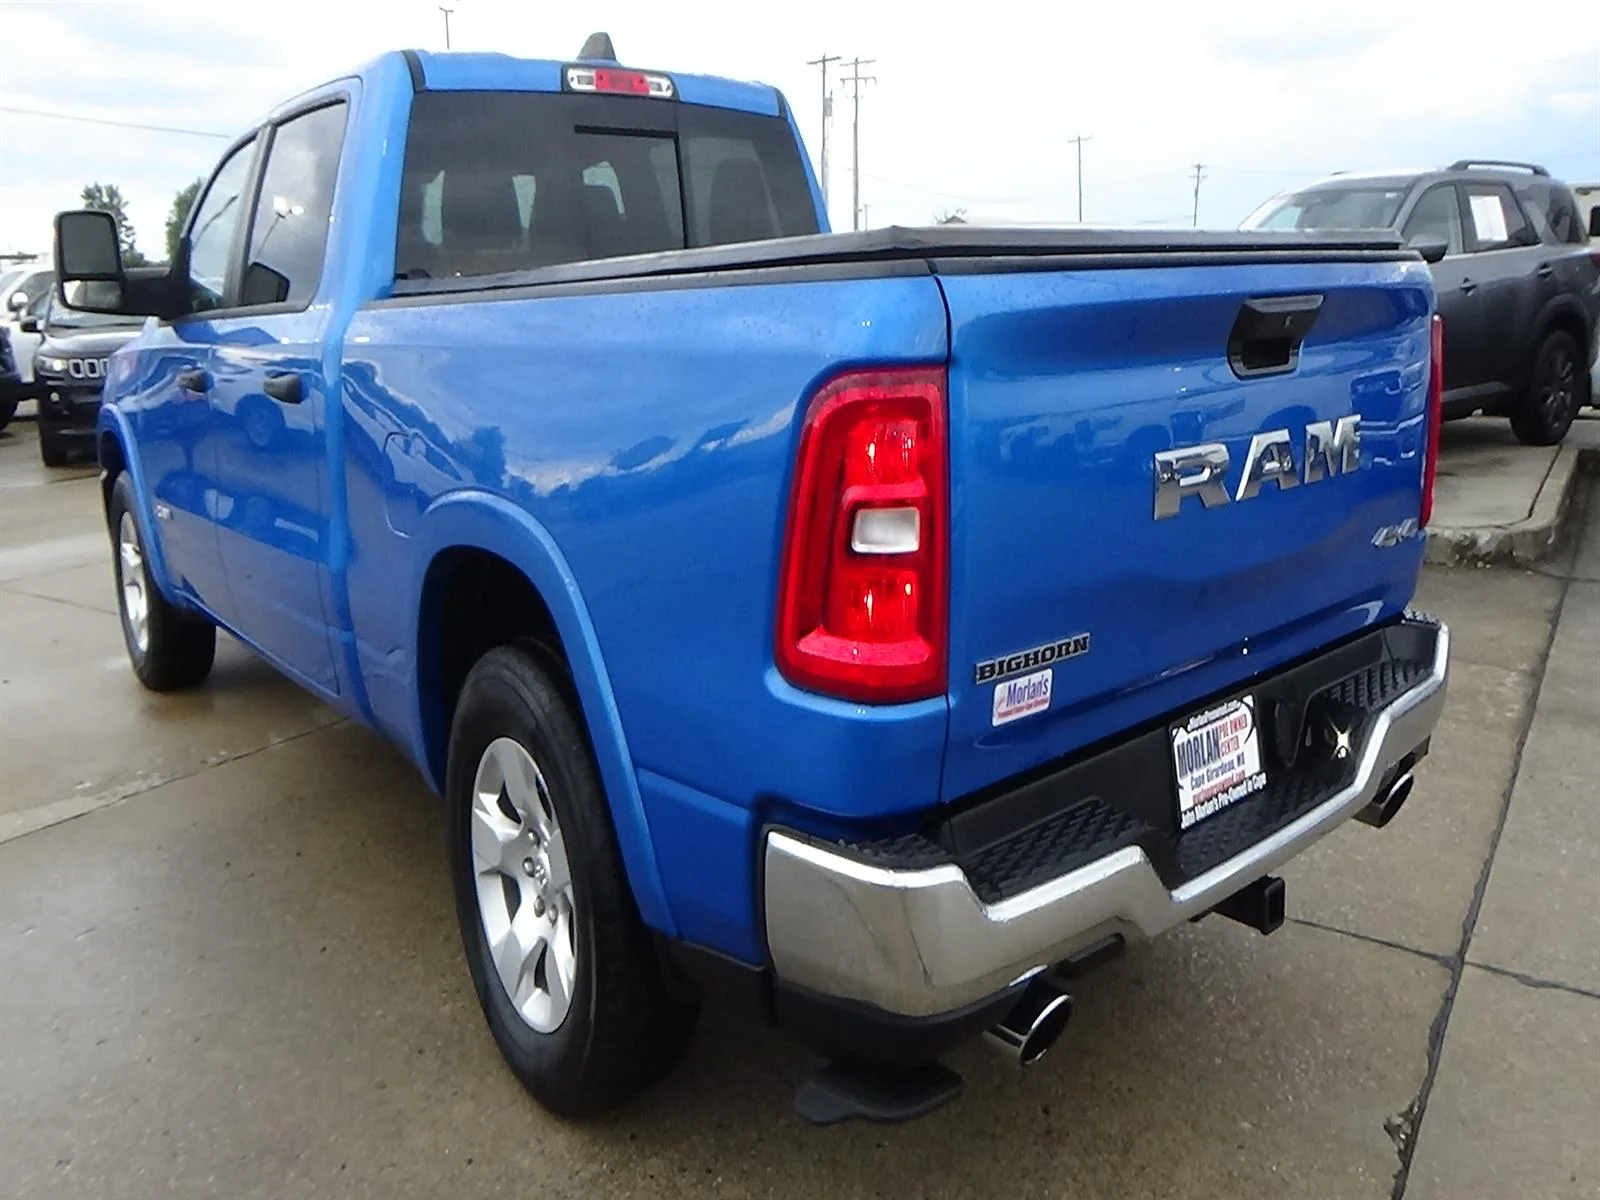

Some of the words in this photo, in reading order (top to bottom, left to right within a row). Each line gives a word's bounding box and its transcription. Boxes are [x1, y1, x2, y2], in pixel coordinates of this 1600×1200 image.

[1153, 413, 1362, 521] RAM
[976, 632, 1091, 685] BIGHORN
[1006, 674, 1049, 707] Morlan's
[1219, 722, 1230, 738] PRE
[1177, 726, 1221, 779] MORLAN
[1190, 773, 1205, 790] Cape
